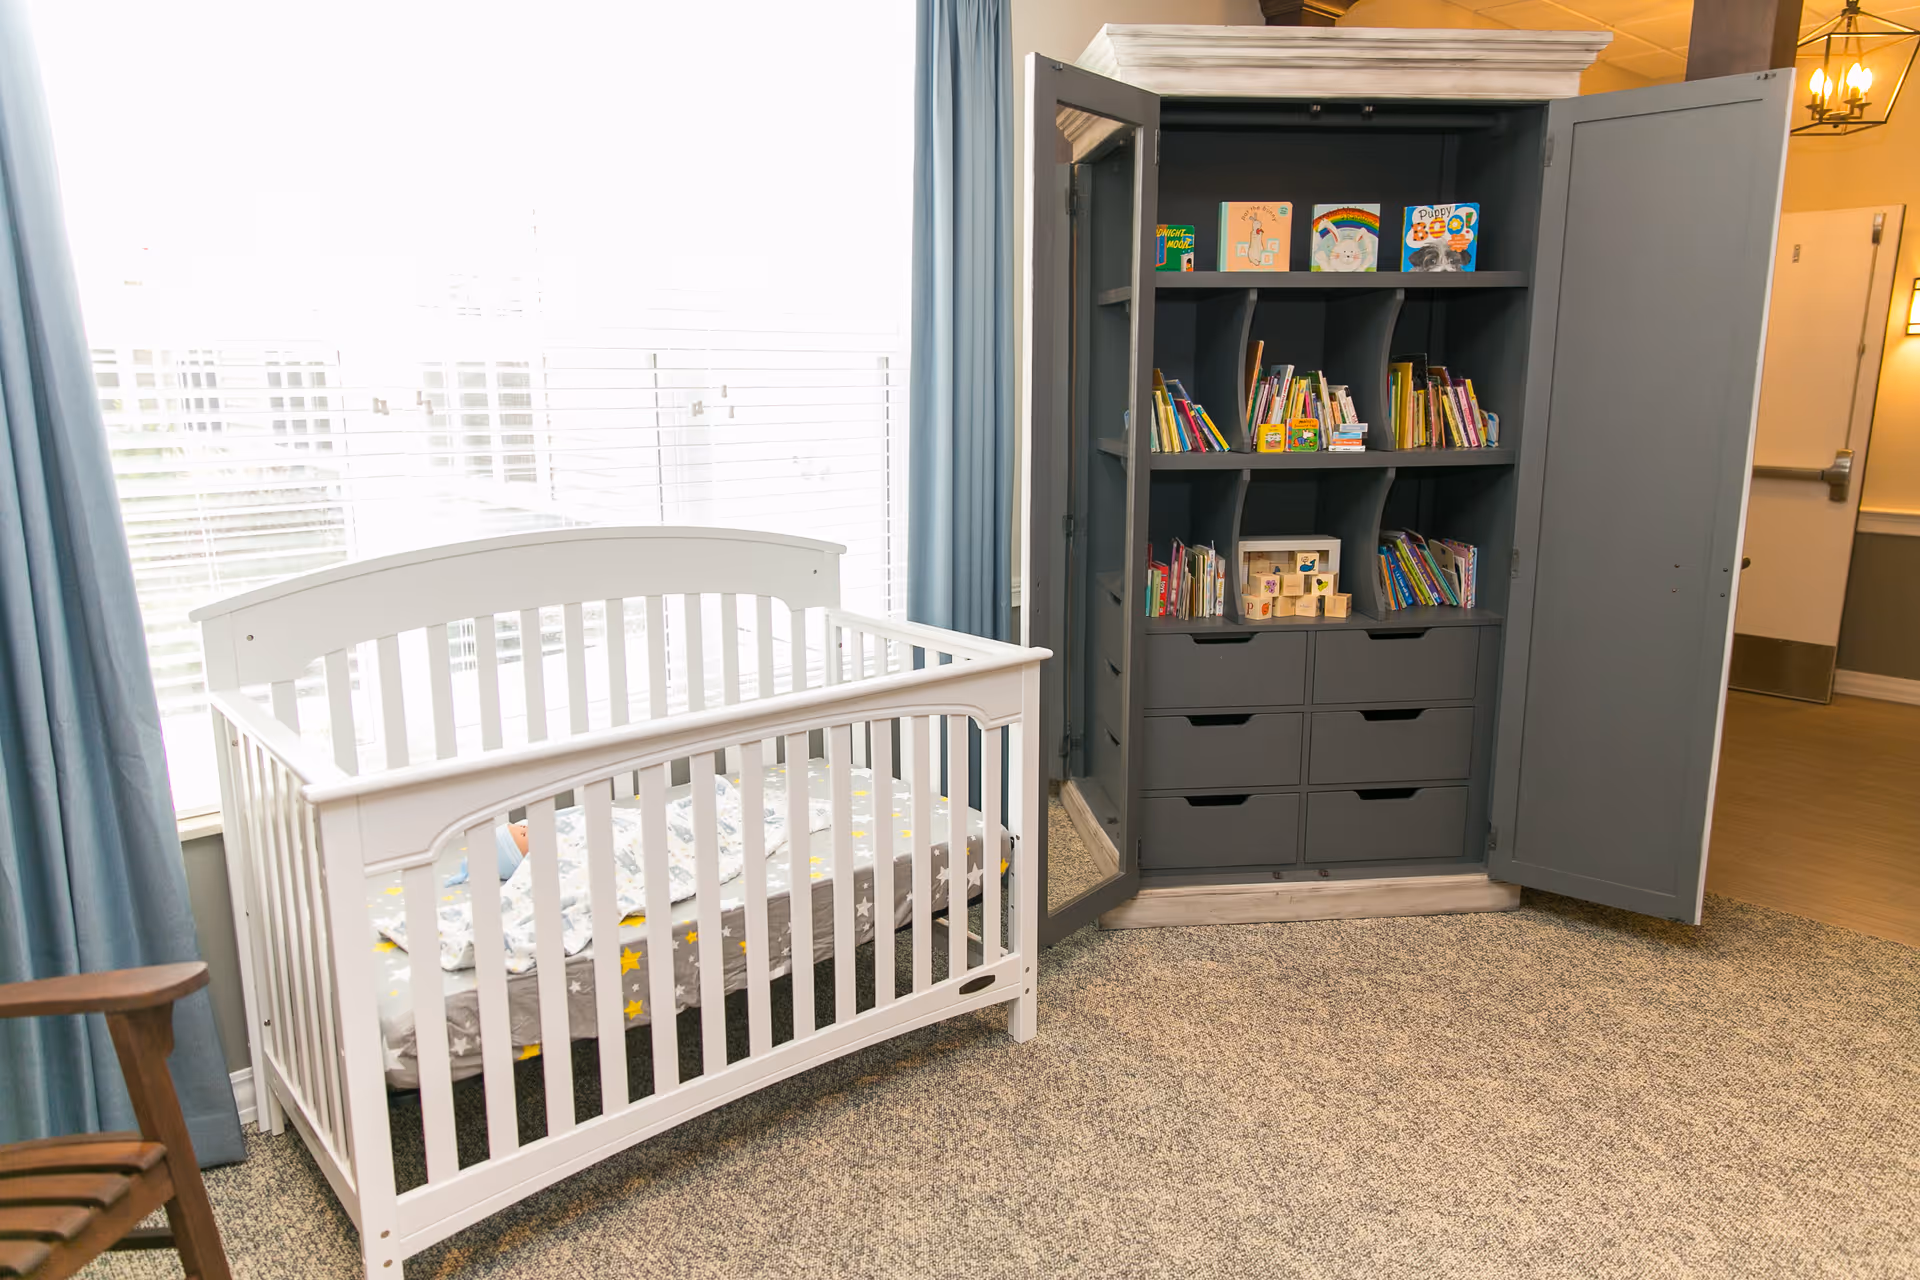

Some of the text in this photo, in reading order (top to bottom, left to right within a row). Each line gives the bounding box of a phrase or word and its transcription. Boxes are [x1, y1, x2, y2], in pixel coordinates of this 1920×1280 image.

[1418, 206, 1452, 221] Puppy
[1411, 211, 1475, 241] BOO!
[1167, 240, 1190, 249] MOON
[1239, 245, 1247, 255] A
[1269, 241, 1277, 251] C
[1246, 602, 1254, 615] P
